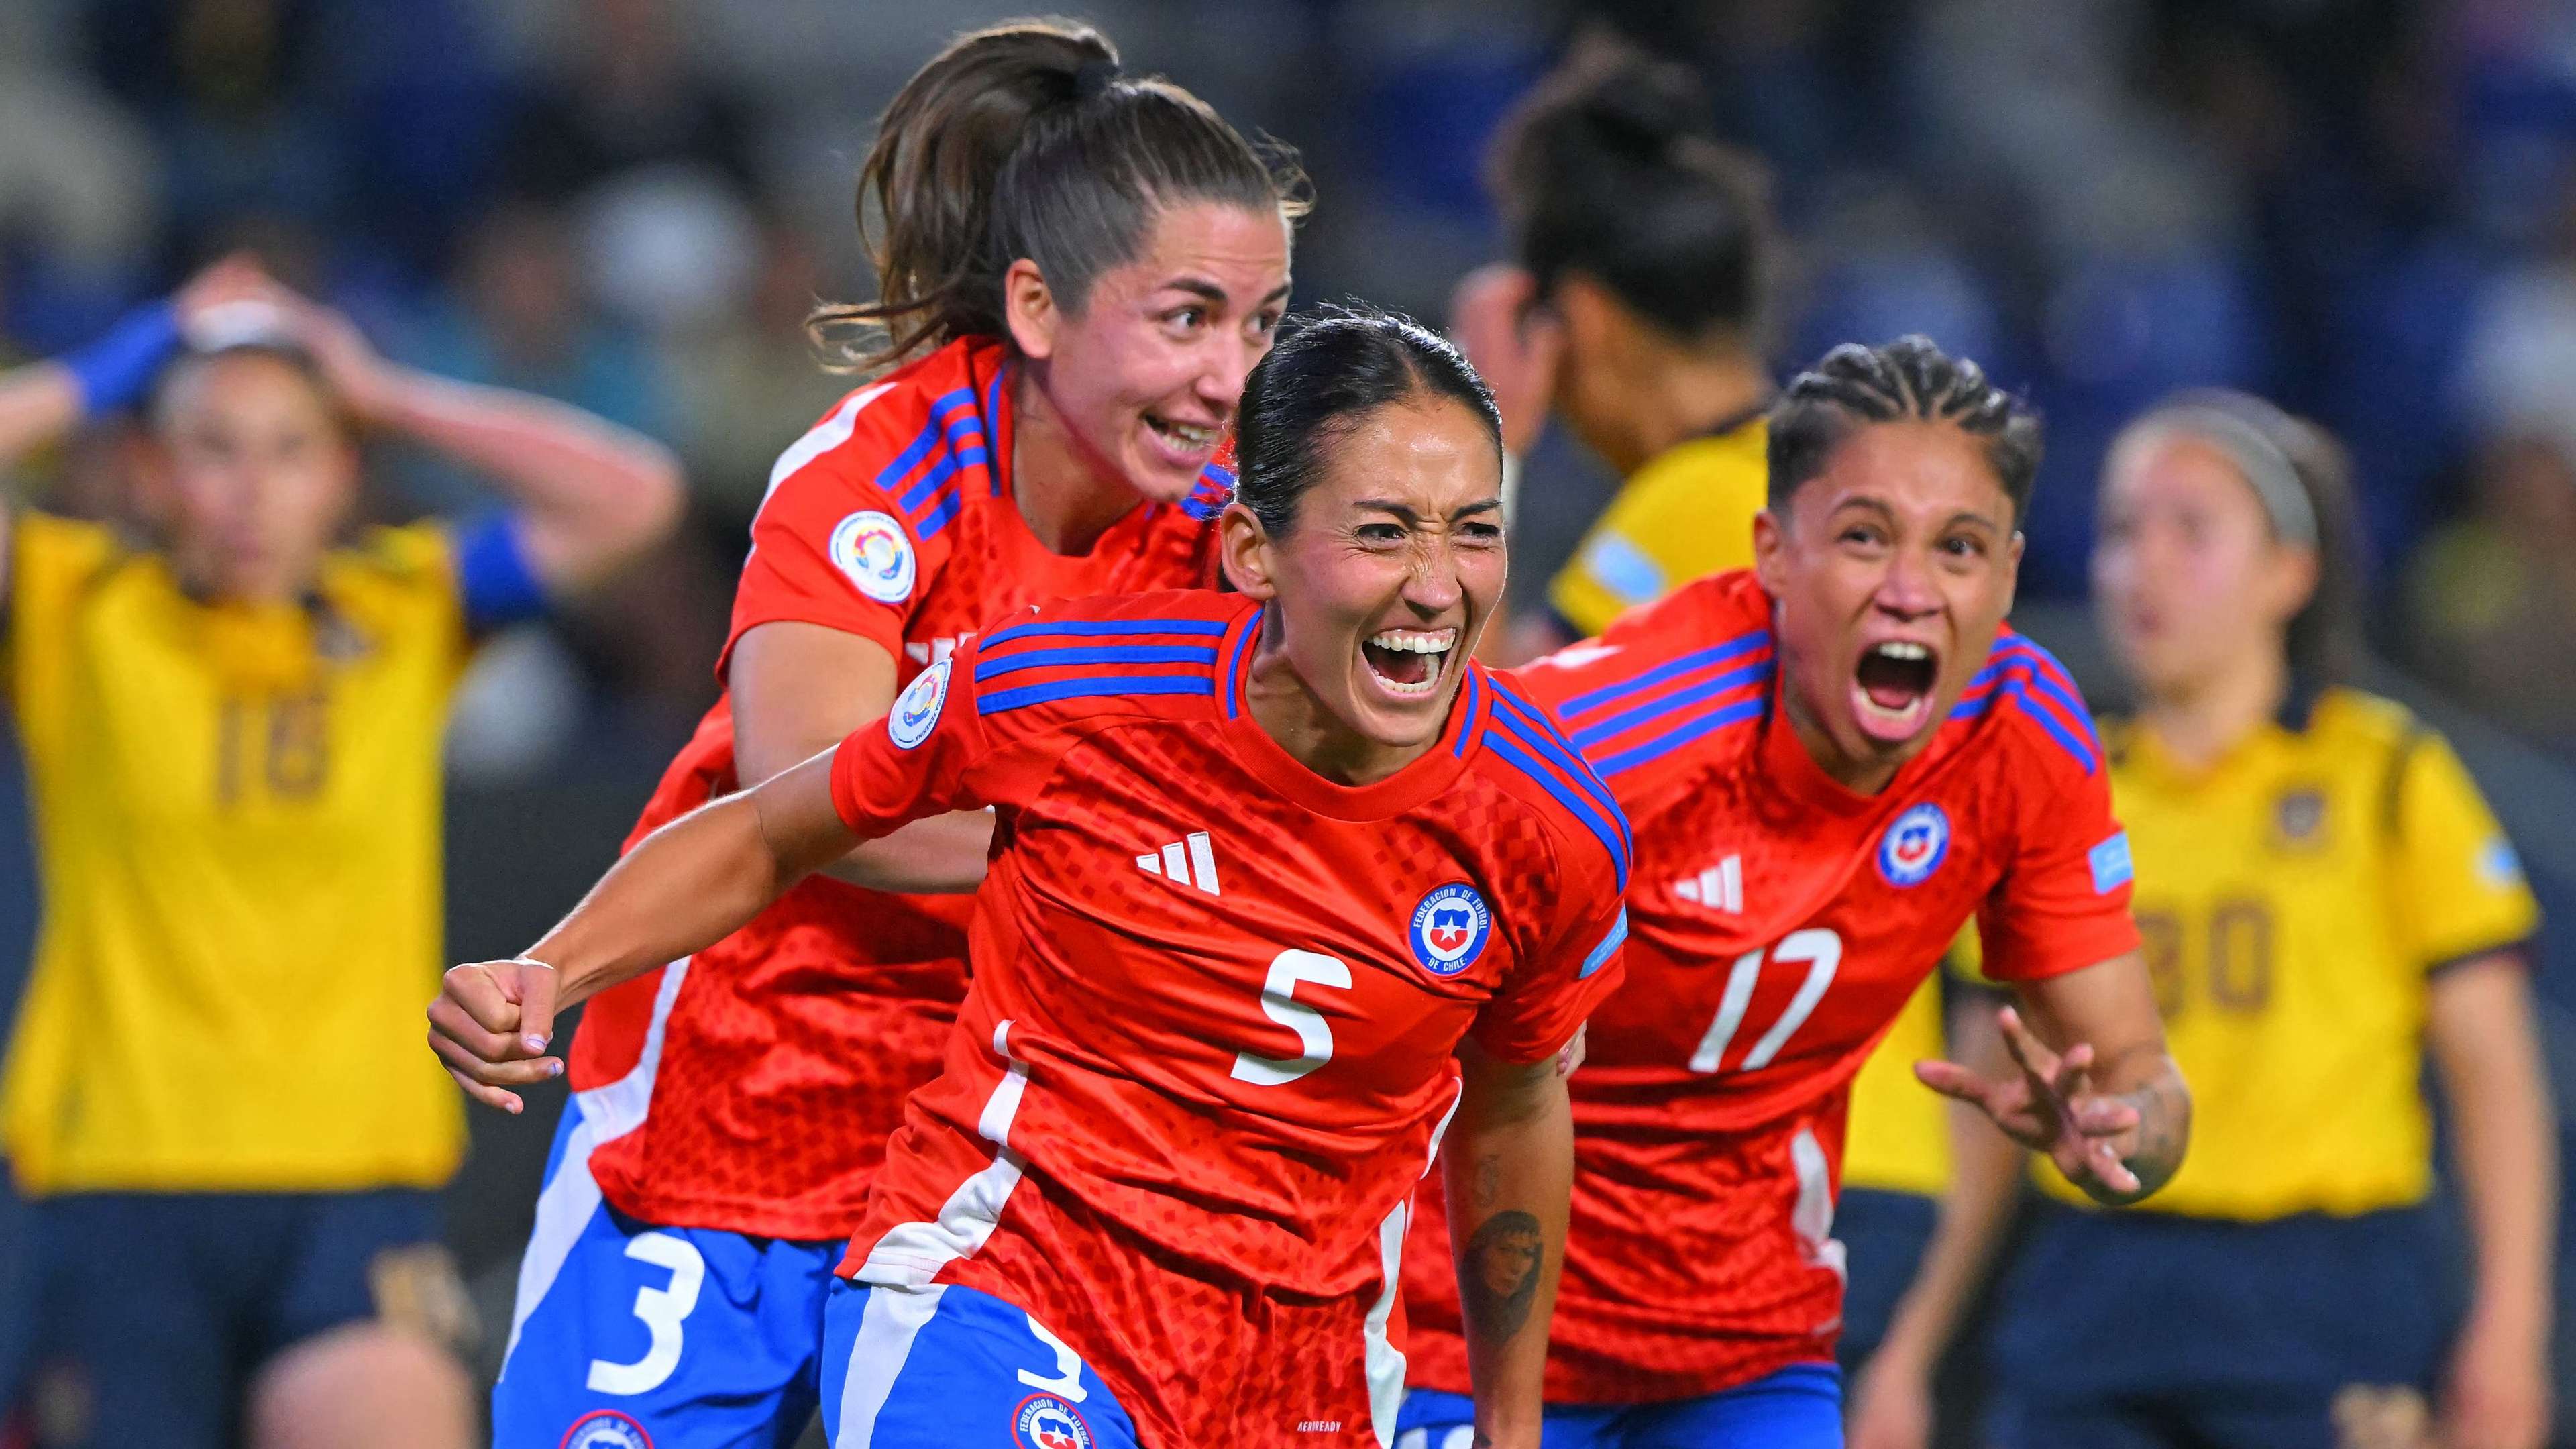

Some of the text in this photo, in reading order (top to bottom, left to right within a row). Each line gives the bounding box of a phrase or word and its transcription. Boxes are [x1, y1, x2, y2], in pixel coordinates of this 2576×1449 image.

[1413, 888, 1487, 930] FEDERACION DE FUTBOL
[1428, 958, 1466, 971] DE CHILE
[1688, 927, 1843, 1073] 17
[1230, 948, 1352, 1086] 5
[586, 1231, 706, 1396] 3
[1019, 1399, 1091, 1446] FEDERACION DE FUTBOL
